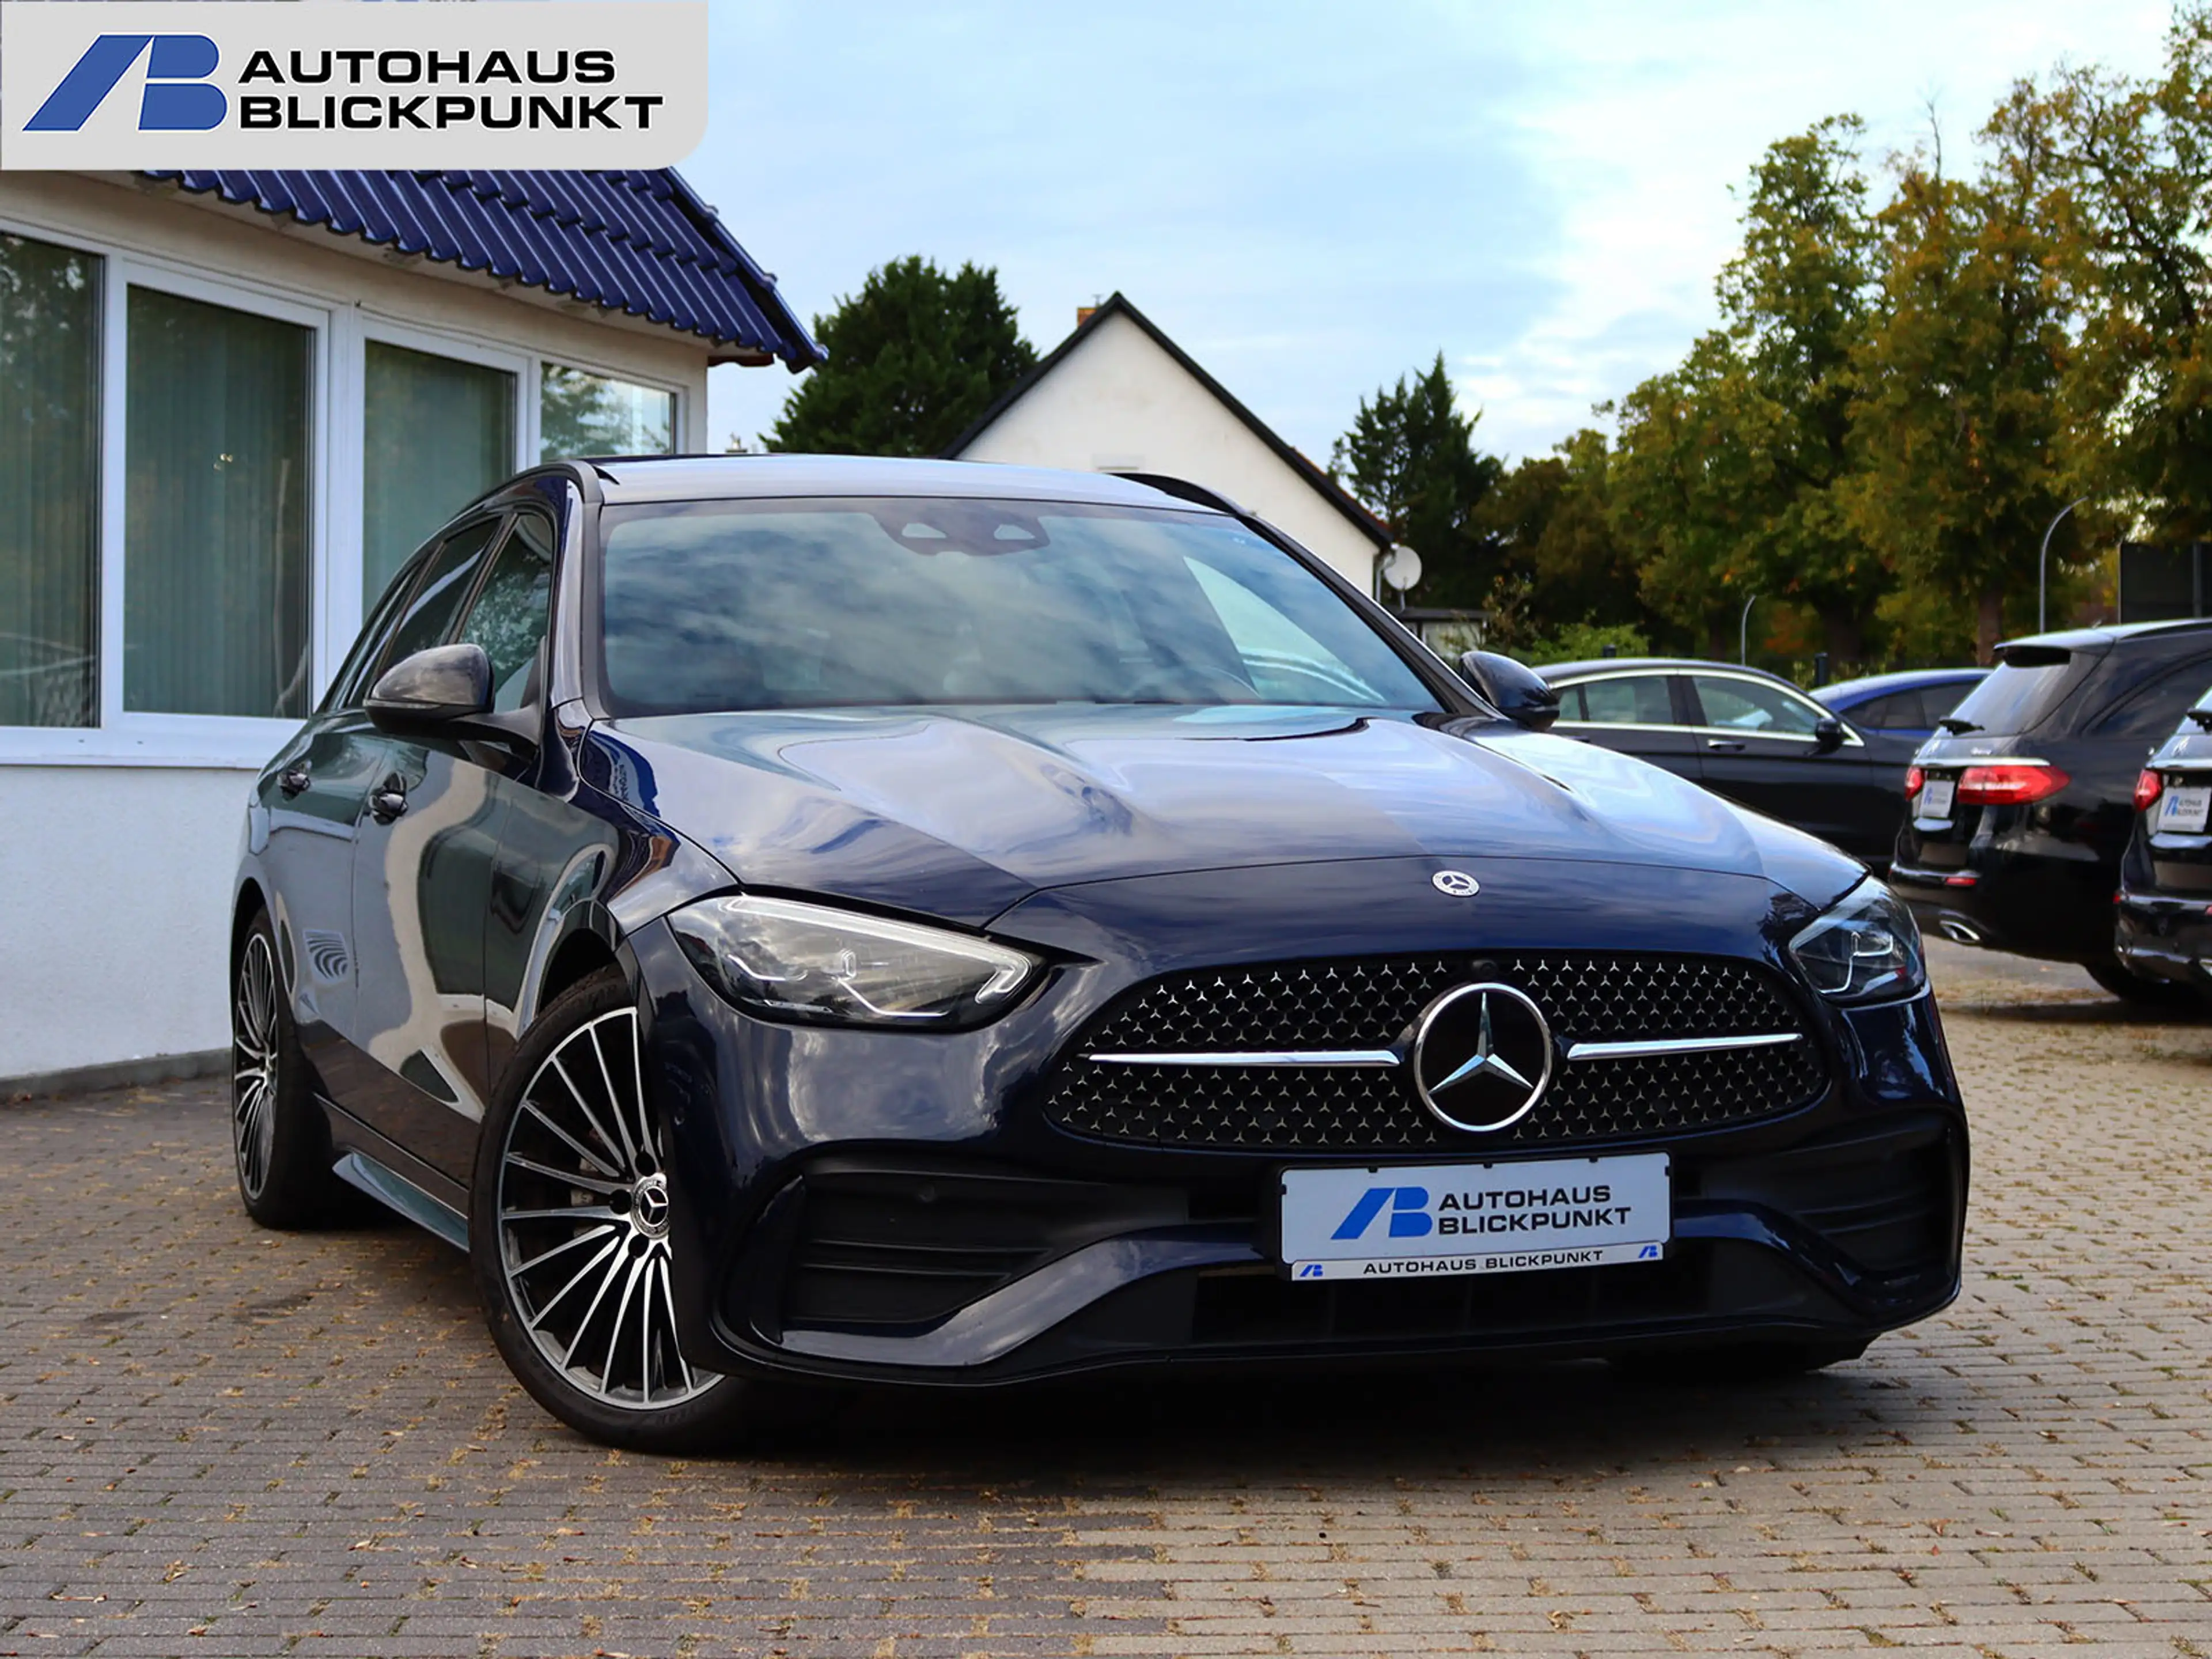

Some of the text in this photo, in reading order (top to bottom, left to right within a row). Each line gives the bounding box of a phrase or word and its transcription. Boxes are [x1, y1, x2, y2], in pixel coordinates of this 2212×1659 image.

[1438, 1185, 1611, 1211] AUTOHAUS
[1438, 1207, 1631, 1235] BLICKPUNKT
[1363, 1258, 1476, 1274] AUTOHAUS
[1486, 1250, 1603, 1269] BLICKPUNKT
